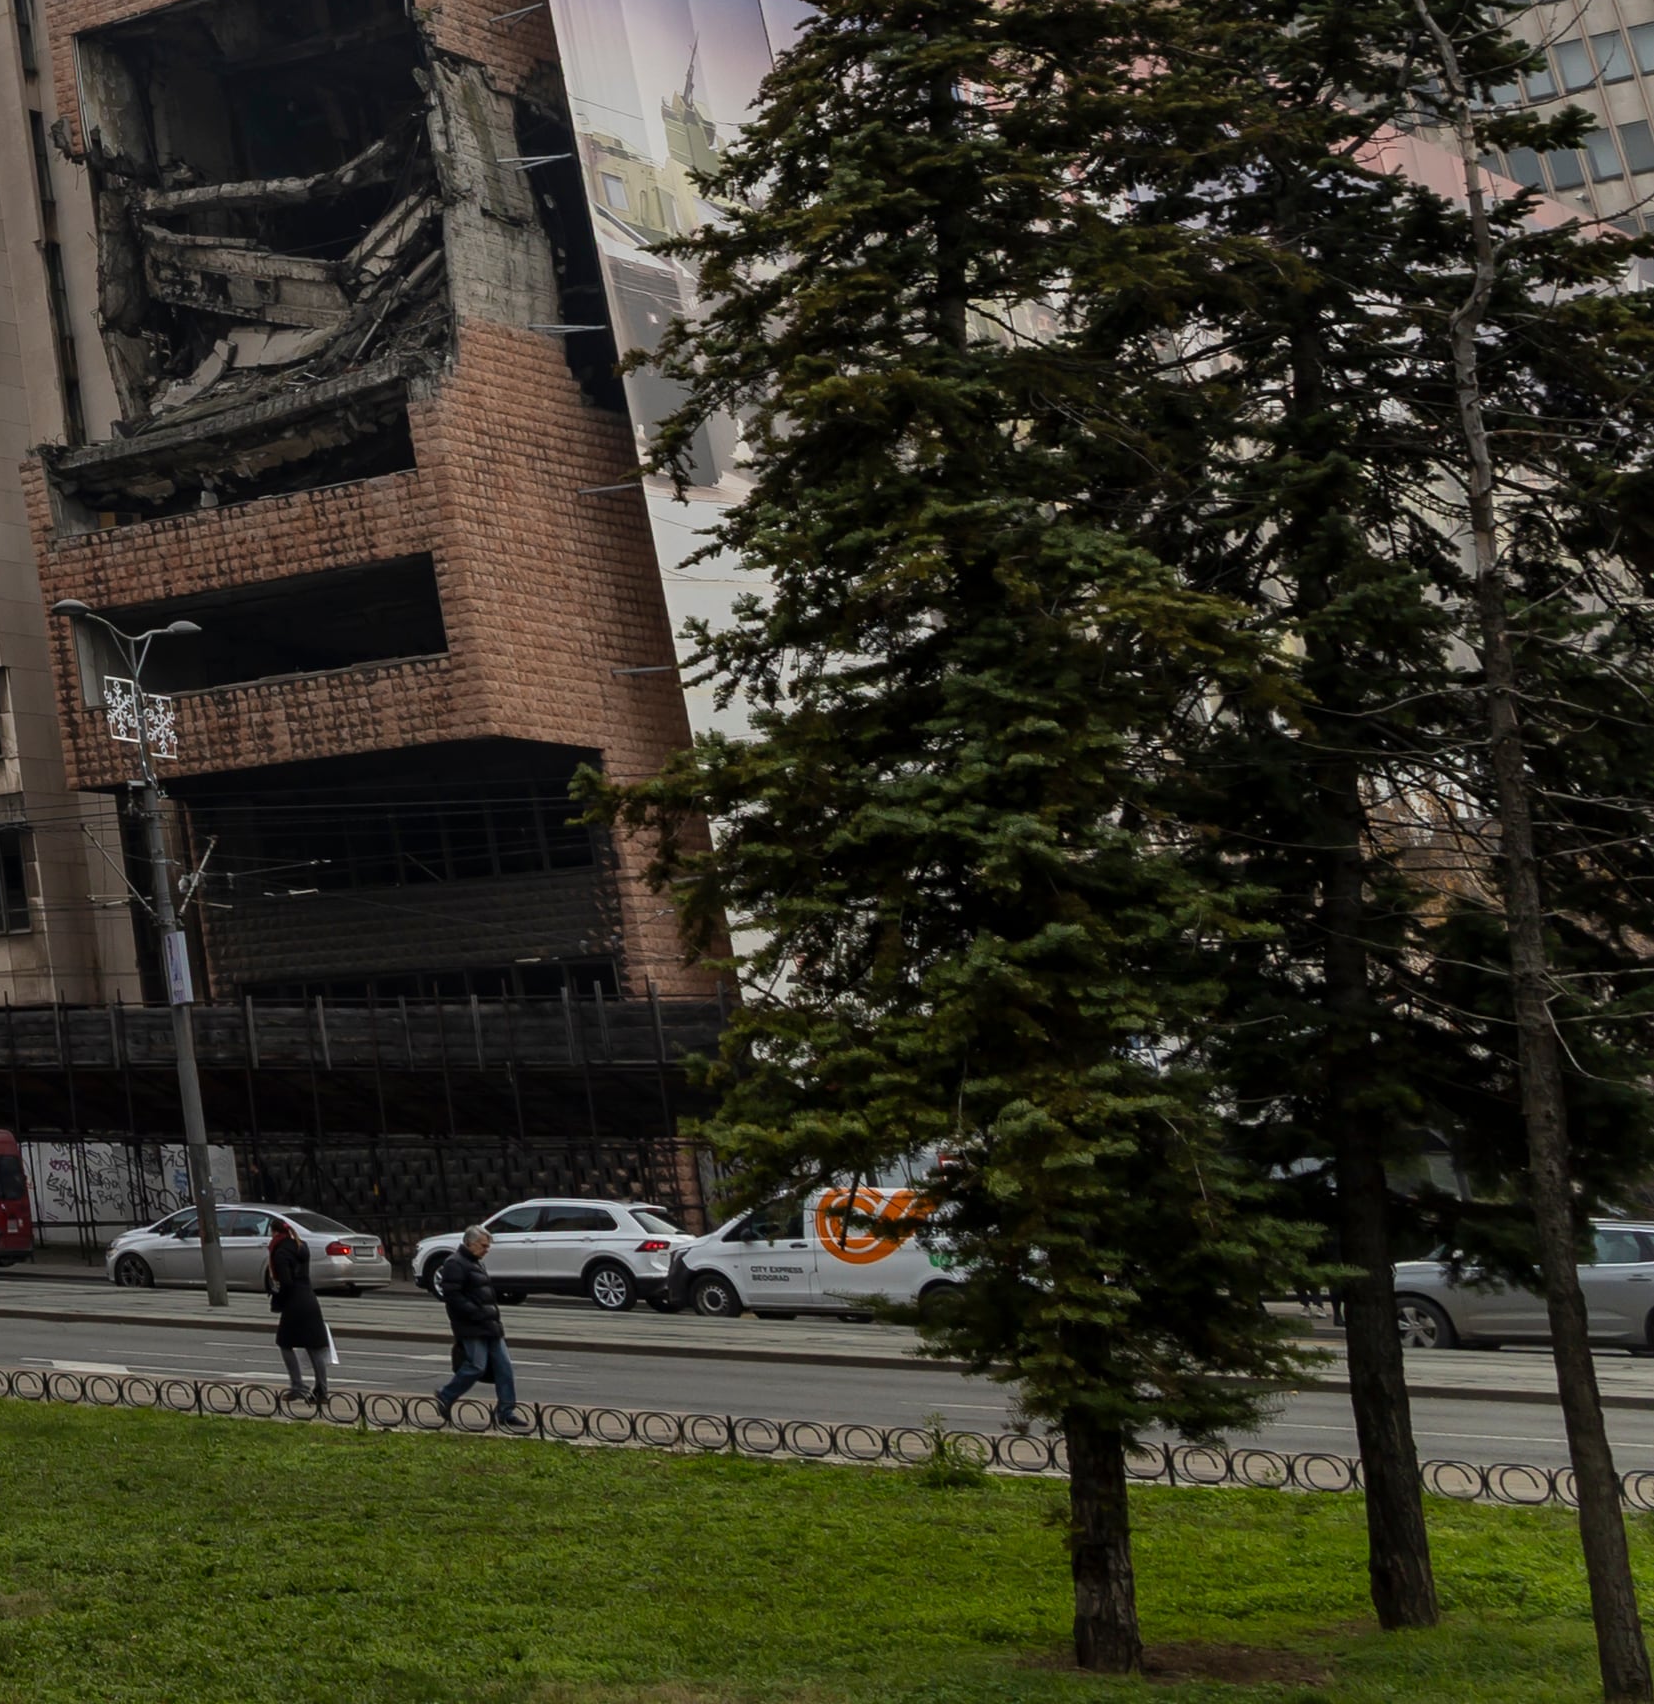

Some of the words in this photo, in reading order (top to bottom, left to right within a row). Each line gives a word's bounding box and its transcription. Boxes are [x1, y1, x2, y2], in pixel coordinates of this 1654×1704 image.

[750, 1265, 768, 1273] CITY
[769, 1265, 804, 1274] EXPRESS
[751, 1274, 790, 1282] BEOGRAD
